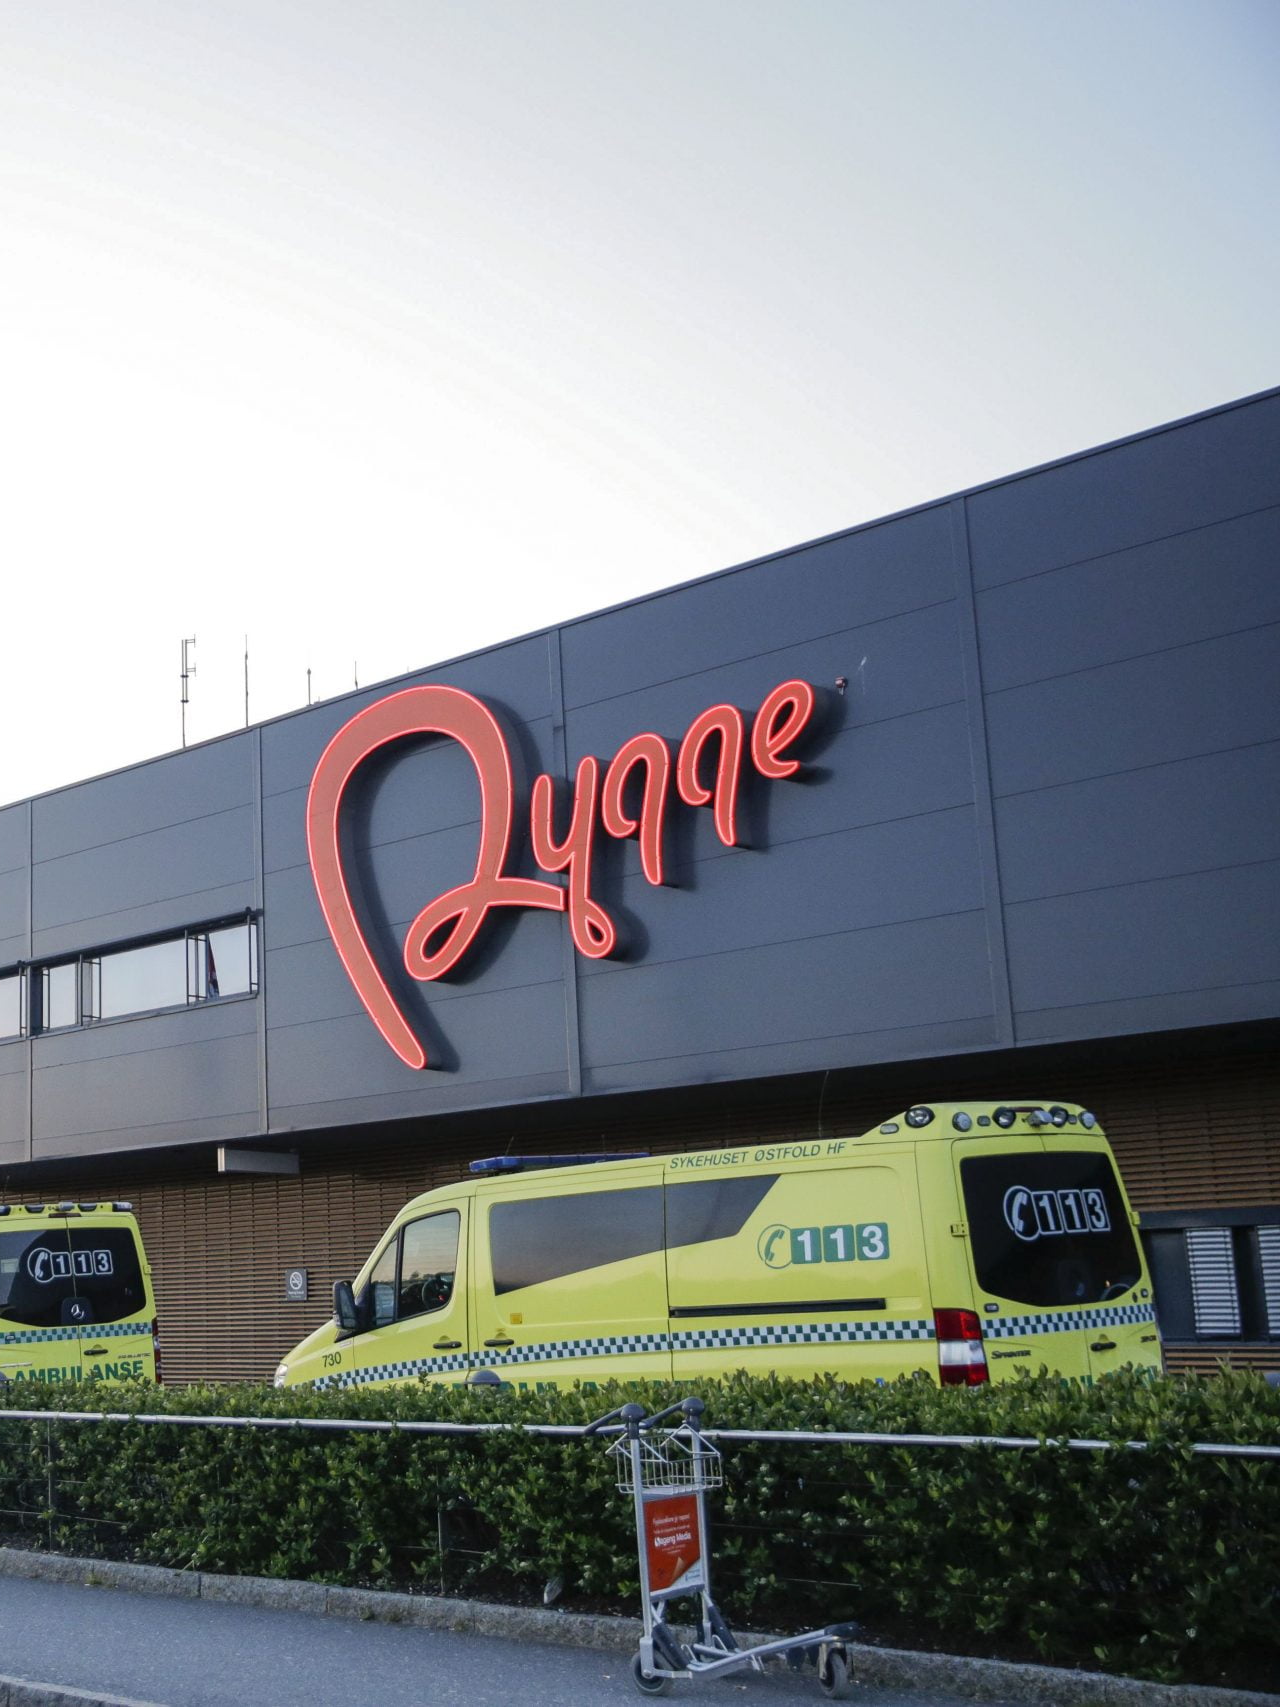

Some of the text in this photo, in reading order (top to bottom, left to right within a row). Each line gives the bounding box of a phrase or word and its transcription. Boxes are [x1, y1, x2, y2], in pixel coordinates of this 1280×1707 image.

[306, 679, 813, 1069] Rygge
[670, 1141, 847, 1169] SYKEHUSET ØSTFOLD HF
[1036, 1190, 1108, 1232] 113
[795, 1224, 887, 1262] 113
[54, 1251, 110, 1275] 113
[322, 1351, 342, 1368] 730
